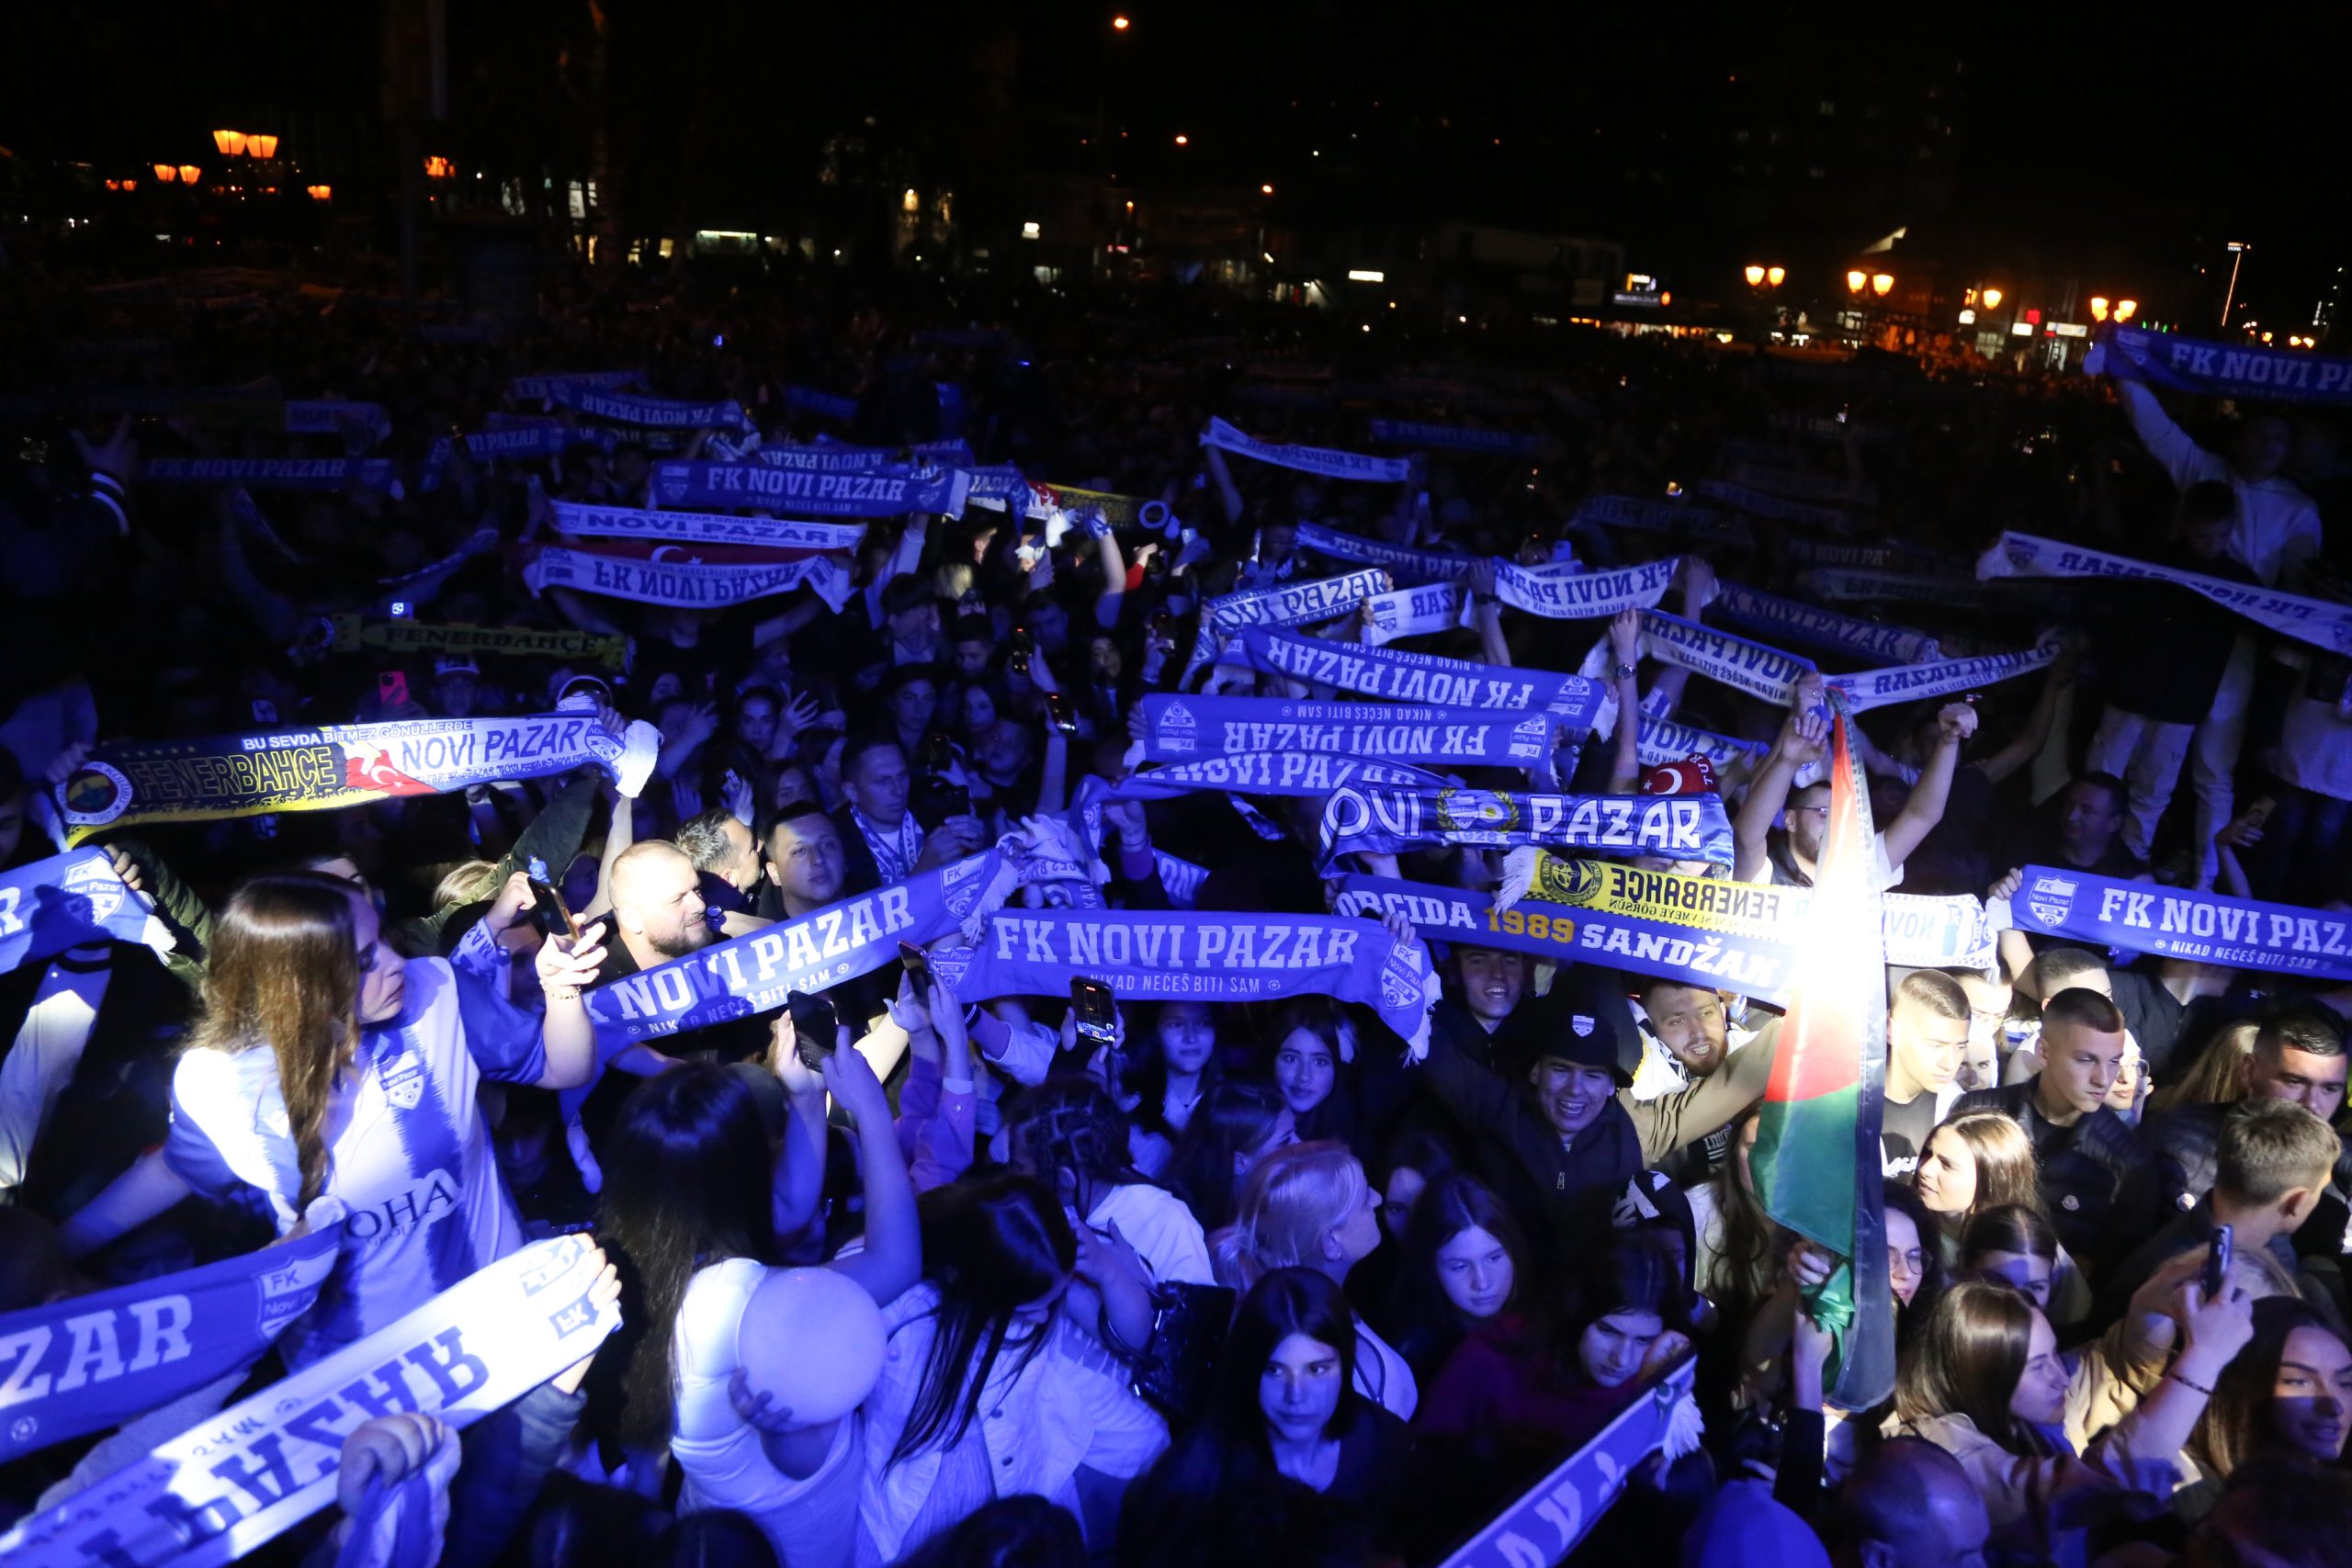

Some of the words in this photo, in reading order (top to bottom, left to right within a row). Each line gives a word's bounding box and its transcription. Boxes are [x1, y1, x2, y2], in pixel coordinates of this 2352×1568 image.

[2171, 343, 2213, 377] FK
[2220, 351, 2312, 389] NOVI
[644, 408, 682, 424] NOVI
[189, 459, 255, 478] NOVI
[260, 459, 346, 478] PAZAR
[707, 467, 742, 491] FK
[748, 468, 814, 497] NOVI
[817, 476, 907, 502] PAZAR
[588, 514, 686, 532] NOVI
[702, 522, 829, 544] PAZAR
[1366, 545, 1420, 572] NOVI
[1213, 598, 1278, 628] OVI
[1281, 570, 1386, 617] PAZAR
[1809, 608, 1904, 656] PAZAR
[1342, 641, 1366, 655] SAM
[1372, 647, 1396, 660] BITI
[1268, 636, 1387, 697] PAZAR
[1438, 656, 1470, 671] NIKAD
[1386, 667, 1481, 708] NOVI
[1480, 680, 1534, 710] FK
[1297, 705, 1321, 718] SAM
[1328, 705, 1351, 720] BITI
[1396, 706, 1431, 720] NIKAD
[243, 738, 266, 751] BU
[268, 733, 322, 749] SEVDA
[378, 719, 474, 739] GÖNÜLLERDE
[1224, 721, 1344, 754] PAZAR
[1348, 724, 1440, 755] NOVI
[1441, 724, 1491, 755] FK
[124, 746, 338, 801] FENERBAHÇE
[400, 733, 477, 773] NOVI
[482, 719, 587, 763] PAZAR
[1325, 786, 1422, 840] OVI
[1526, 795, 1702, 851] PAZAR
[88, 883, 121, 892] Pazar
[946, 867, 962, 882] FK
[2039, 881, 2052, 891] FK
[1484, 908, 1576, 944] 1989
[2098, 887, 2155, 928] FK
[2160, 897, 2262, 945] NOVI
[2268, 913, 2352, 954] PAZ
[610, 948, 749, 1019] NOVI
[749, 886, 915, 982] PAZAR
[993, 917, 1058, 964] FK
[1067, 922, 1185, 969] NOVI
[1195, 924, 1360, 972] PAZAR
[1397, 947, 1415, 964] FK
[2171, 940, 2210, 956] NIKAD
[2257, 951, 2284, 966] BITI
[2288, 955, 2318, 970] SAM
[1194, 976, 1224, 993] BITI
[1230, 978, 1261, 993] SAM
[648, 1014, 698, 1033] NIKAD
[798, 968, 831, 992] SAM
[271, 1268, 300, 1291] FK
[0, 1293, 194, 1410] ZAR
